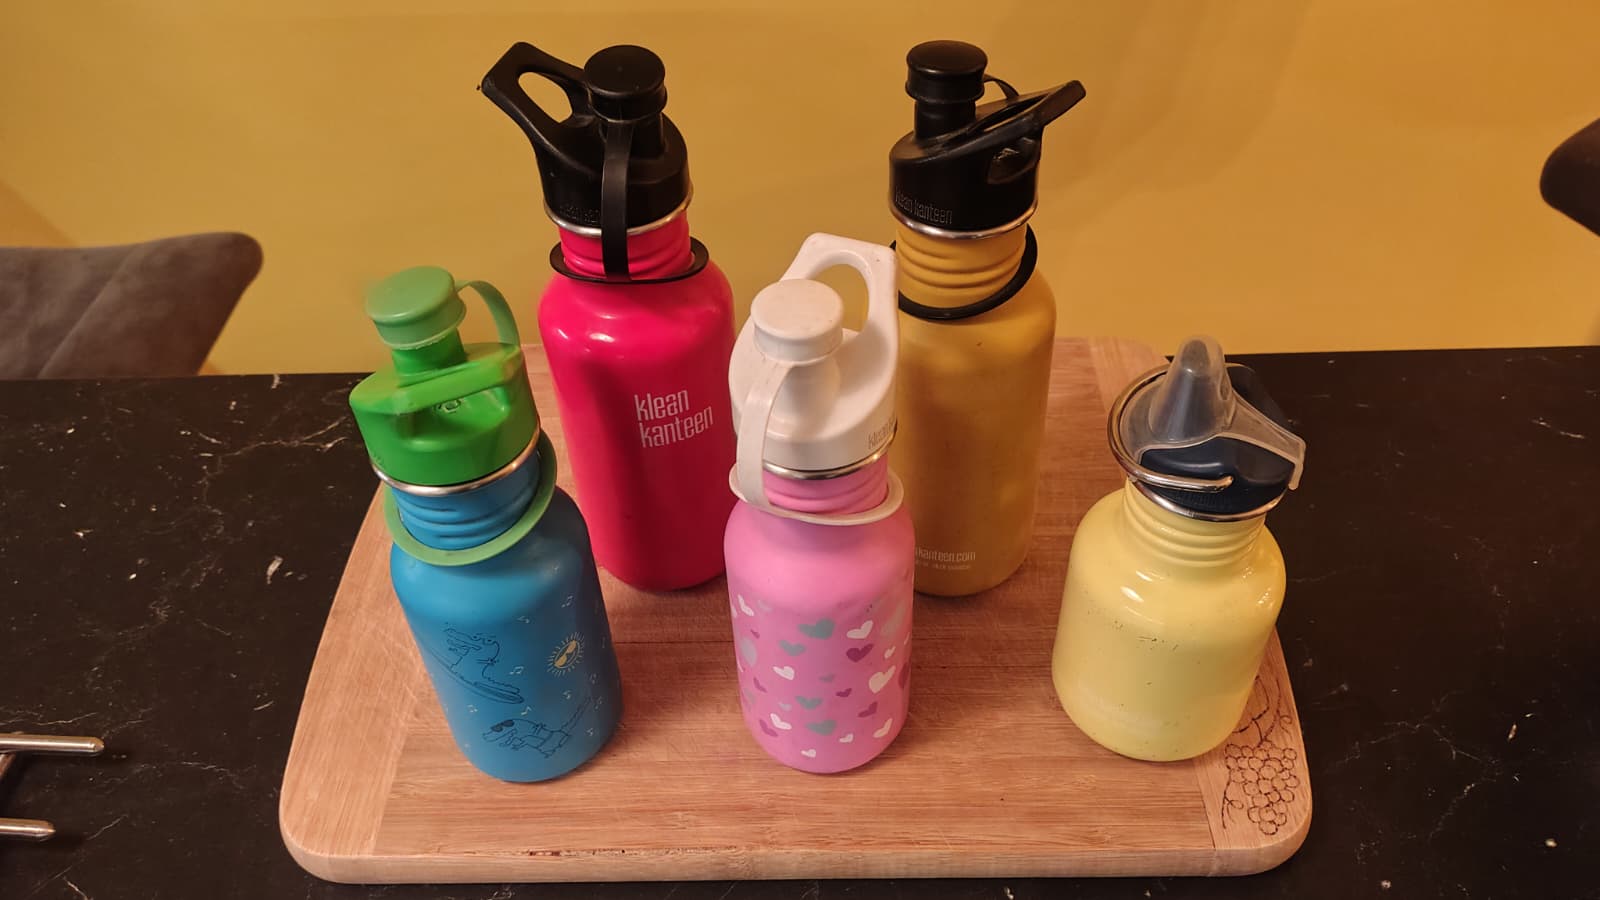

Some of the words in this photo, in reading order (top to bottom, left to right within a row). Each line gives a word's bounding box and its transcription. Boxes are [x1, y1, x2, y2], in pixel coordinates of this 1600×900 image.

[914, 200, 953, 225] kanteen
[634, 389, 689, 421] klean
[639, 405, 714, 448] kanteen
